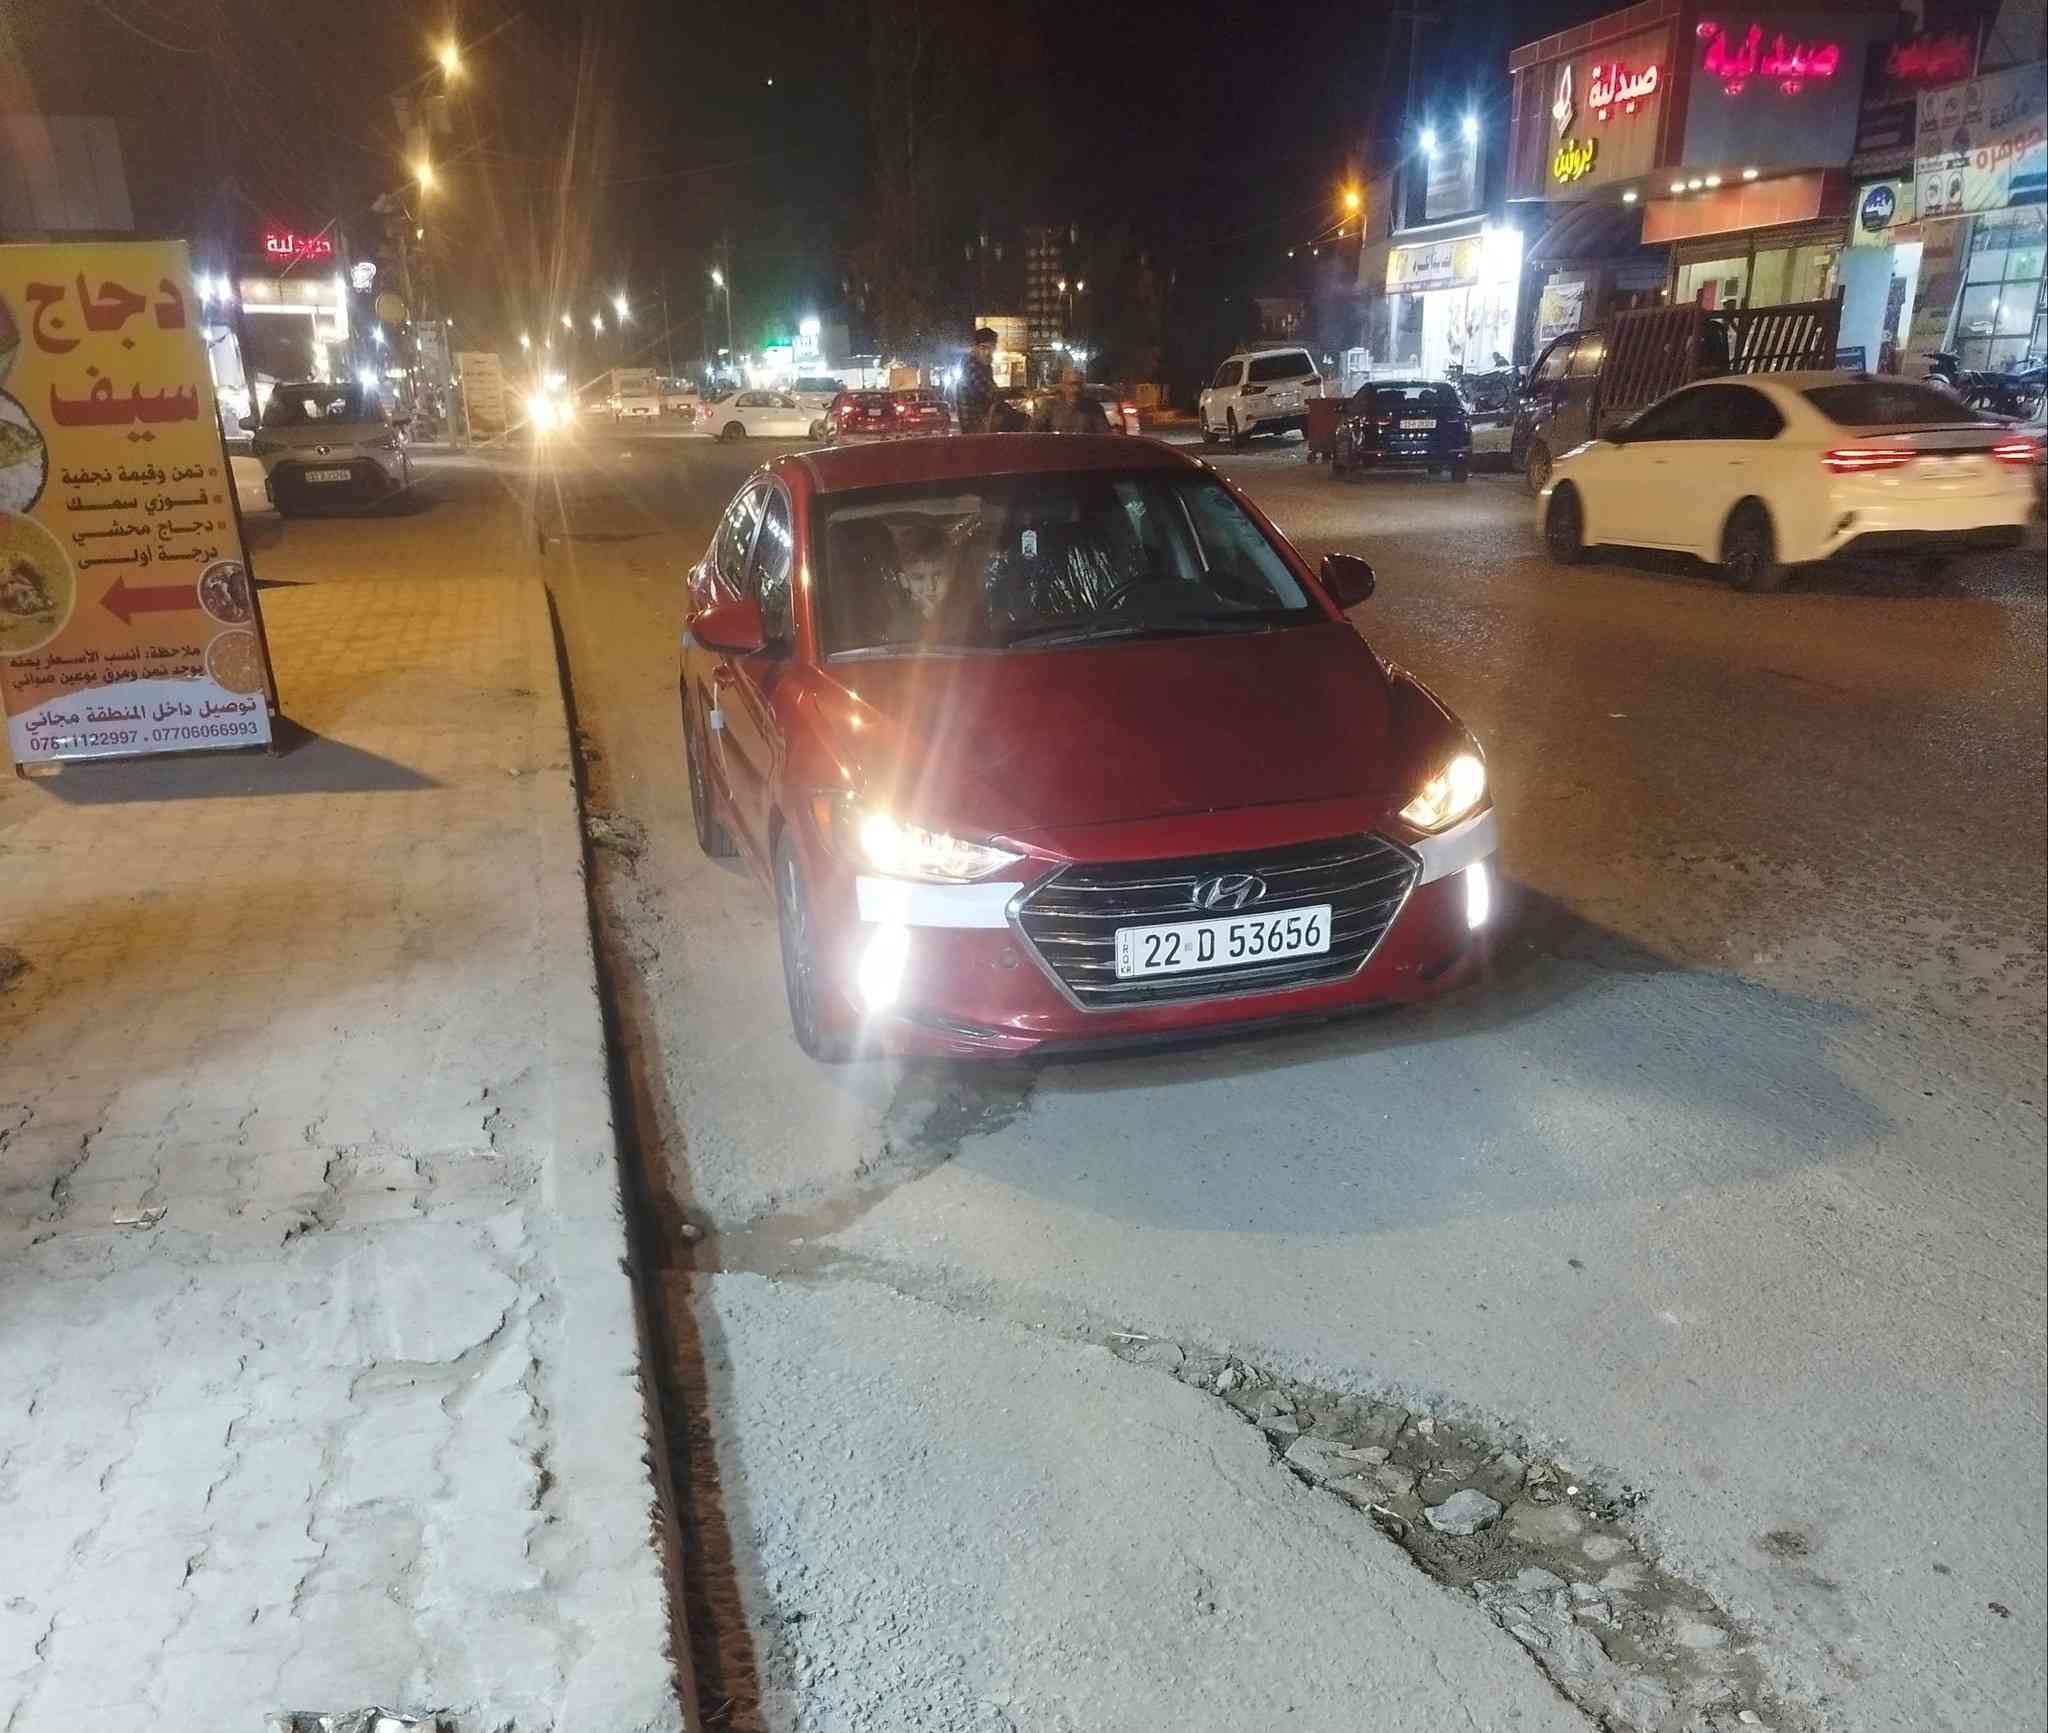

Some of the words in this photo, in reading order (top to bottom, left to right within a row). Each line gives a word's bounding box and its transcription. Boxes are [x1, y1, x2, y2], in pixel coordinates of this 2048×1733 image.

[1697, 22, 1840, 95] صيدلية
[1589, 64, 1658, 120] صيدلية
[1553, 138, 1594, 183] بروتين
[26, 272, 187, 353] دجاج
[50, 365, 199, 442] سيف
[62, 468, 112, 488] نجفية
[119, 465, 165, 485] وقيمة
[172, 464, 203, 481] تمن
[66, 496, 137, 511] سمك
[72, 519, 150, 546] محشي
[158, 520, 213, 540] دجاج
[158, 546, 218, 563] درجة
[88, 705, 146, 723] المنطقة
[152, 703, 193, 722] داخل
[199, 698, 256, 718] توصيل
[25, 712, 81, 735] مجاني
[153, 722, 258, 743] 07706066993
[1144, 932, 1181, 968] 22
[1197, 929, 1215, 961] D
[1229, 915, 1321, 957] 53656
